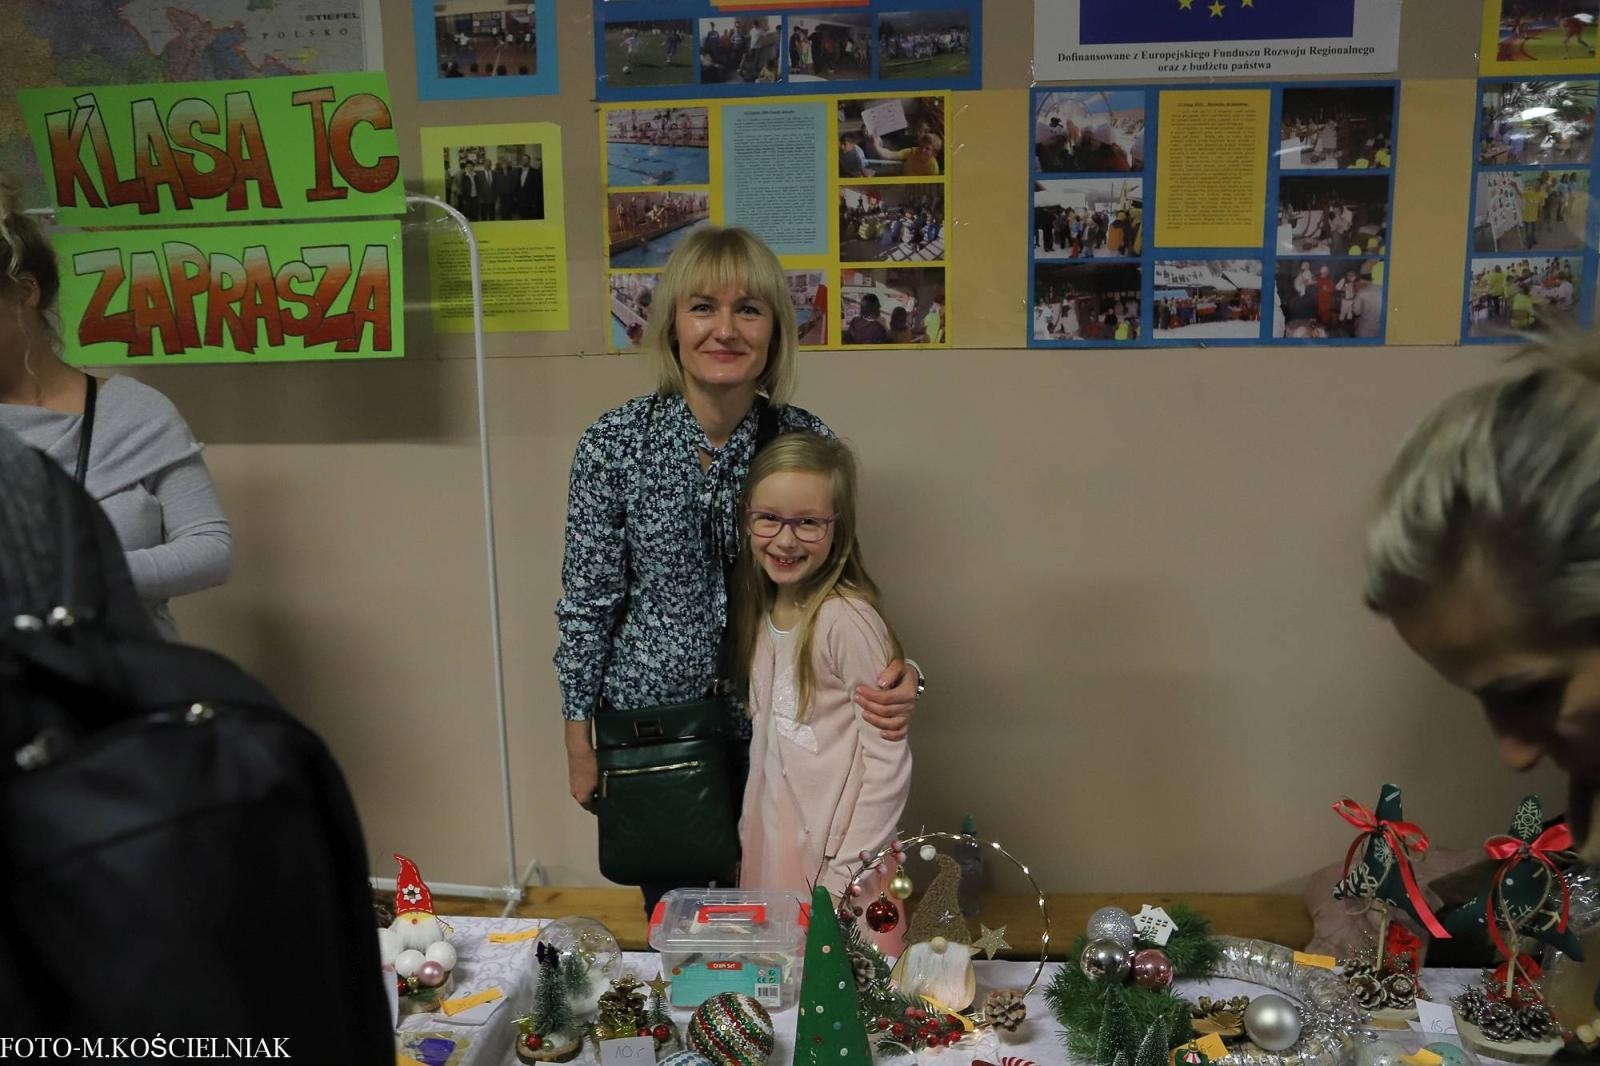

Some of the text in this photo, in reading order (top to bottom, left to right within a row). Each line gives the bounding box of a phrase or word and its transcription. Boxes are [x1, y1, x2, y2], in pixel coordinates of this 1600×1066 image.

[305, 12, 360, 21] STIEFEL
[1058, 45, 1375, 62] Dofinansowane z Europejskiego Funduszu Rozwoju Regionalnego
[1158, 64, 1179, 72] oraz
[1190, 62, 1228, 71] budżetu
[1231, 61, 1271, 72] państwa
[44, 92, 282, 214] KLASA
[72, 241, 392, 357] ZAPRASZA
